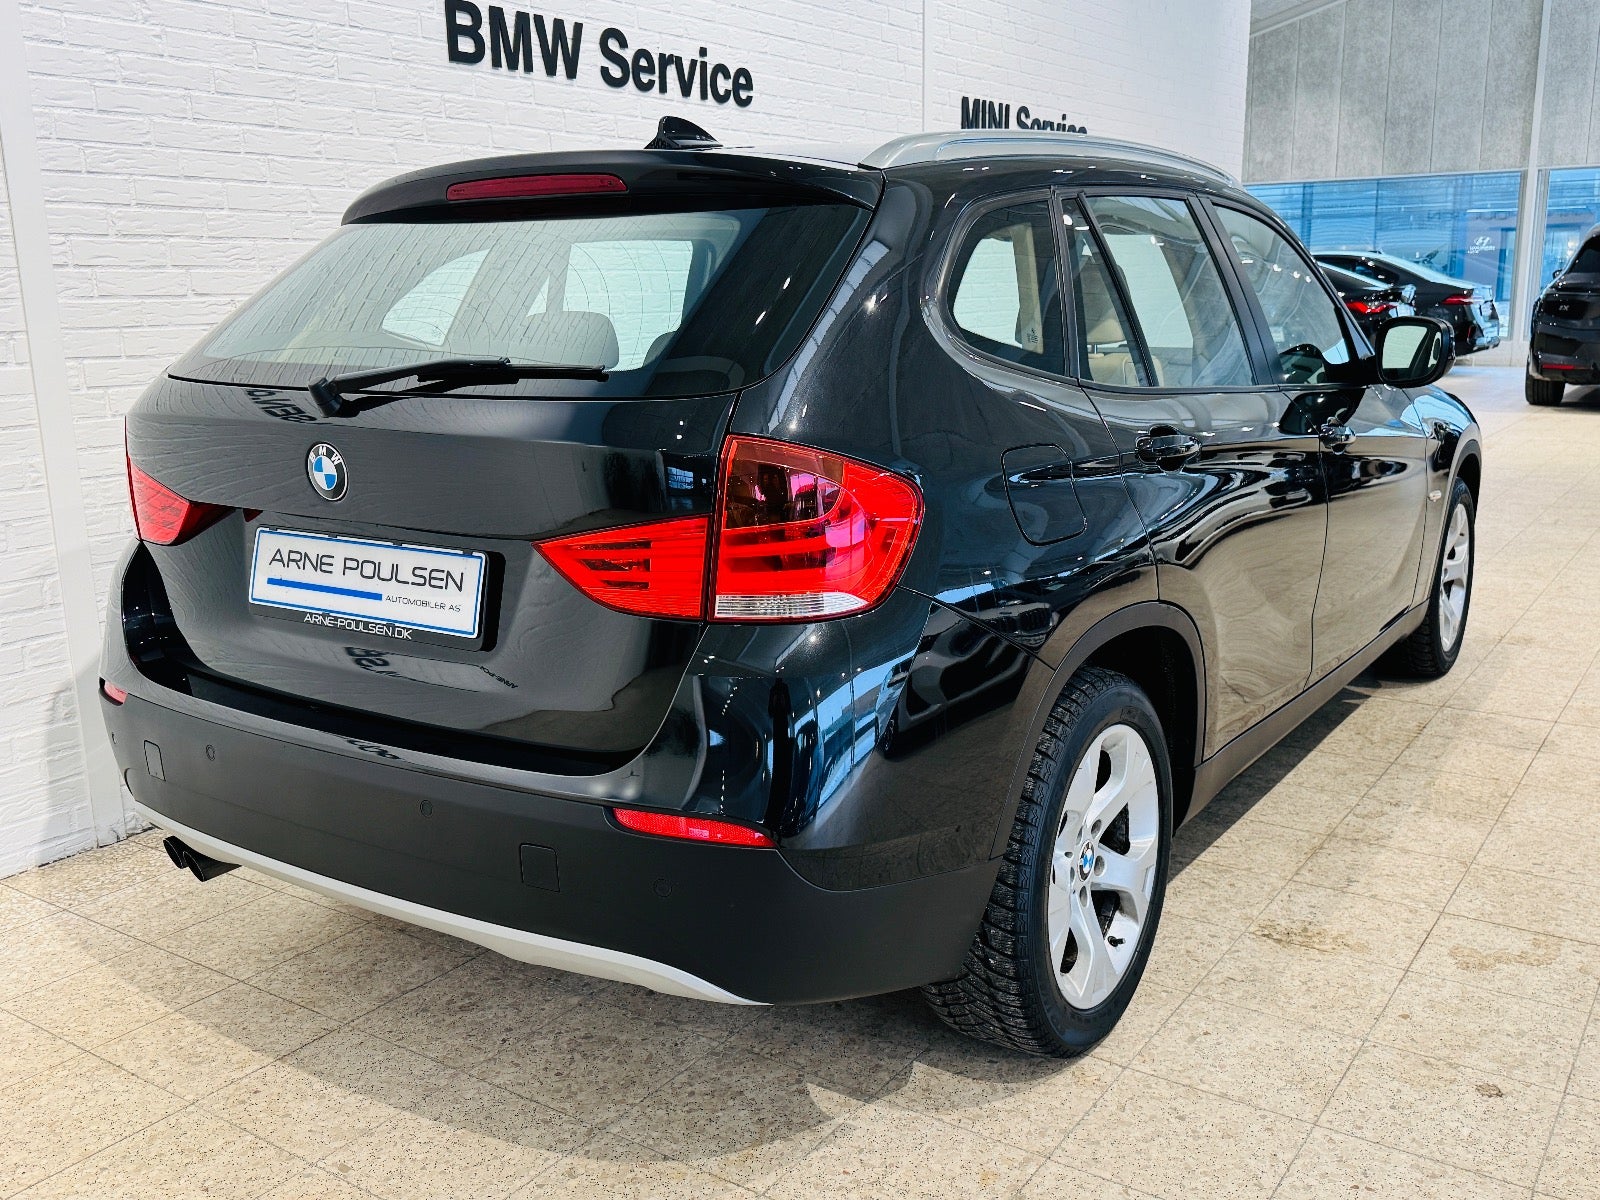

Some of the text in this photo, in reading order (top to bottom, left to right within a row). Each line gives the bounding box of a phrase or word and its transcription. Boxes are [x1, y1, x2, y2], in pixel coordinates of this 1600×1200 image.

[445, 0, 754, 107] BMW Service
[960, 96, 1011, 130] MINI
[308, 445, 342, 465] BMW
[268, 547, 464, 592] ARNE POULSEN
[385, 594, 446, 610] AUTOMOBILER
[303, 612, 413, 640] ARNE-POULSEN.DK
